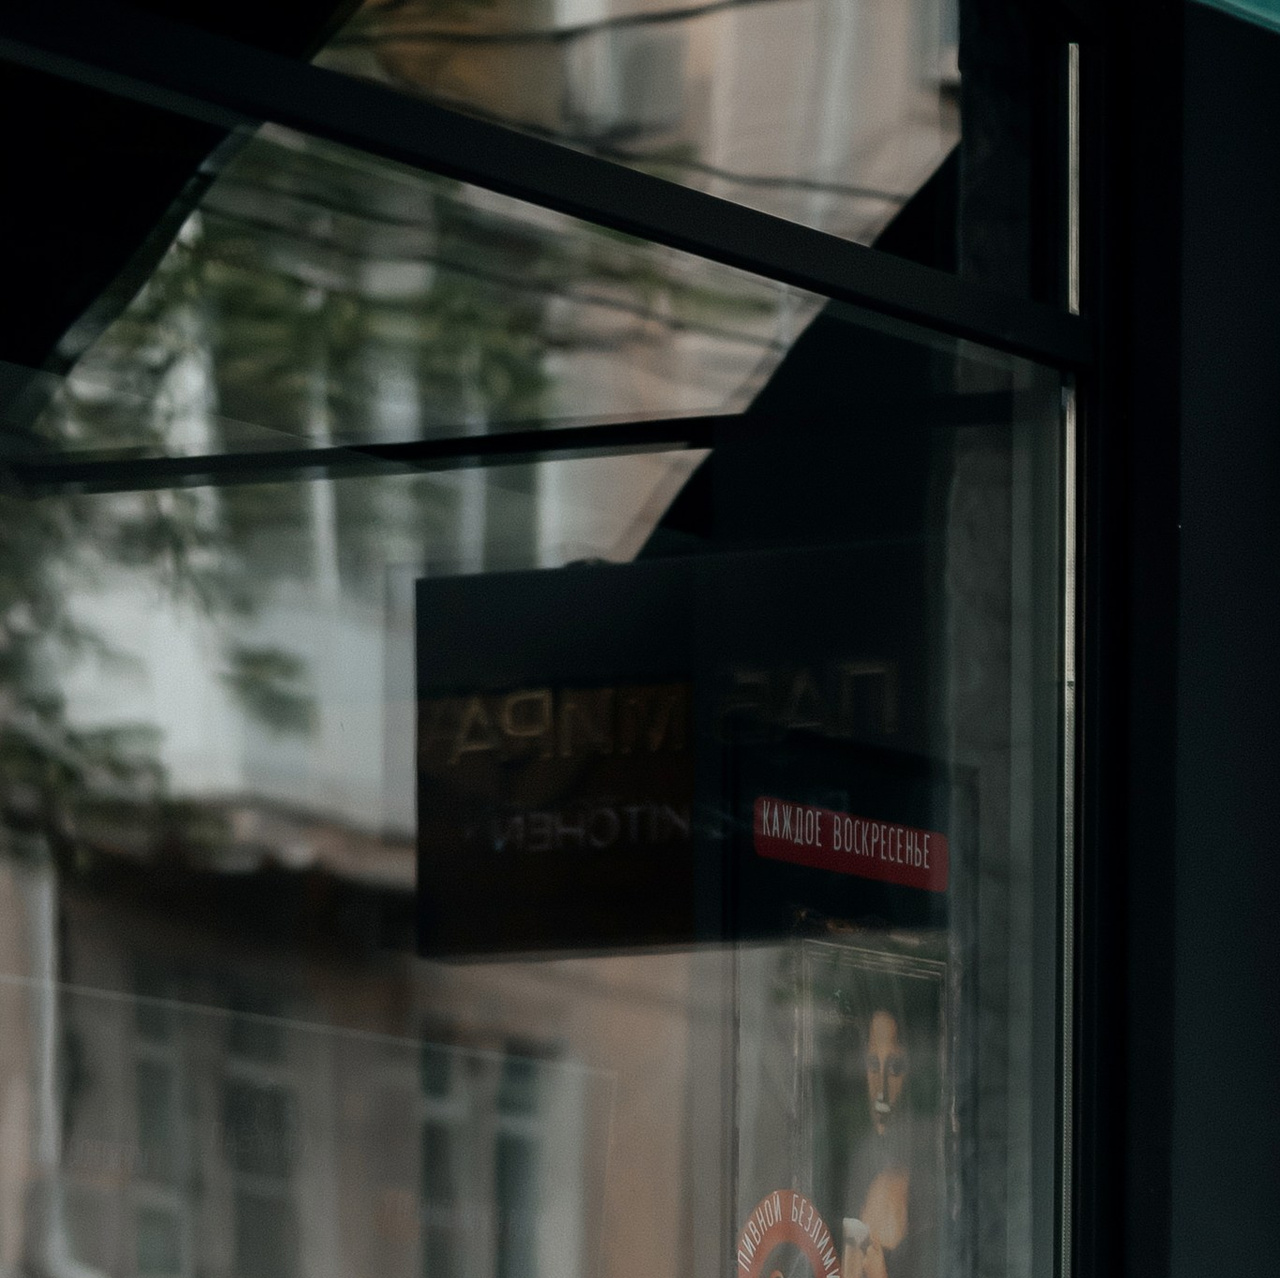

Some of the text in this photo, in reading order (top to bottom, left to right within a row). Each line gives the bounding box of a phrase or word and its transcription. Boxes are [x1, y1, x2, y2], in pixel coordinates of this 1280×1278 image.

[762, 800, 822, 848] КАЖДОЕ
[833, 814, 931, 870] ВОСКРЕСЕНЬЕ
[737, 1190, 782, 1272] ПИВНОЙ
